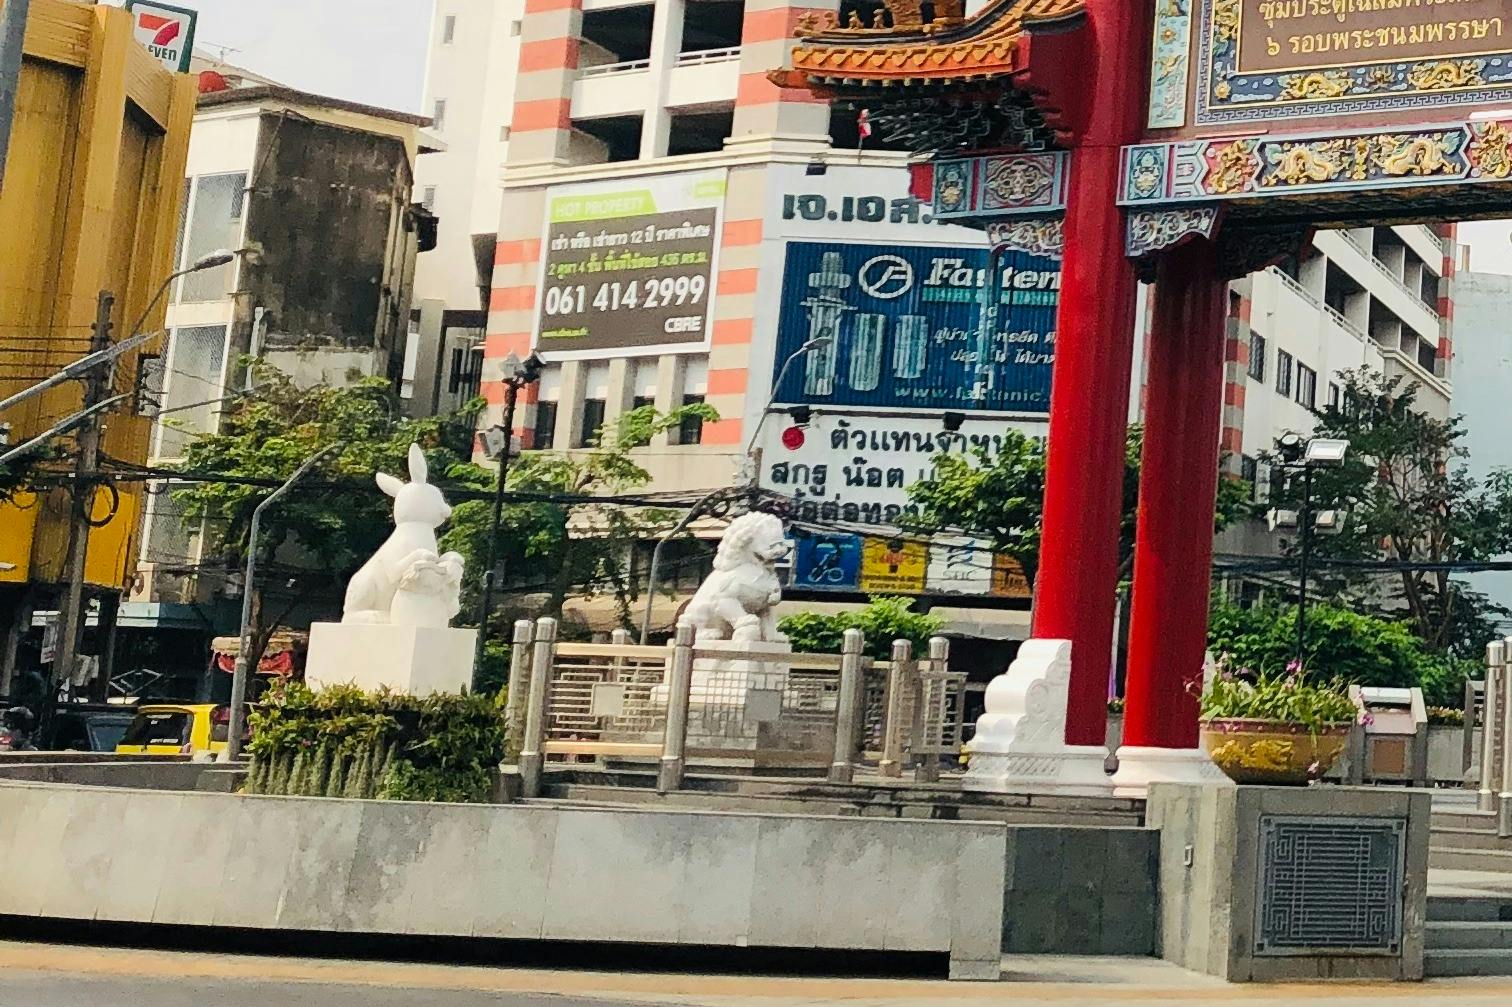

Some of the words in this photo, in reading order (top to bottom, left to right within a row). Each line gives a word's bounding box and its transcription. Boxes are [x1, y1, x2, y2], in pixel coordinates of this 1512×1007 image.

[138, 12, 181, 46] 7
[1267, 37, 1281, 56] ๖
[1289, 17, 1502, 54] รอบพระชนมพรรษา
[545, 285, 586, 316] 061
[593, 280, 639, 312] 414
[643, 274, 706, 309] 2999
[664, 316, 702, 333] CBRE
[770, 461, 828, 497] สกรู
